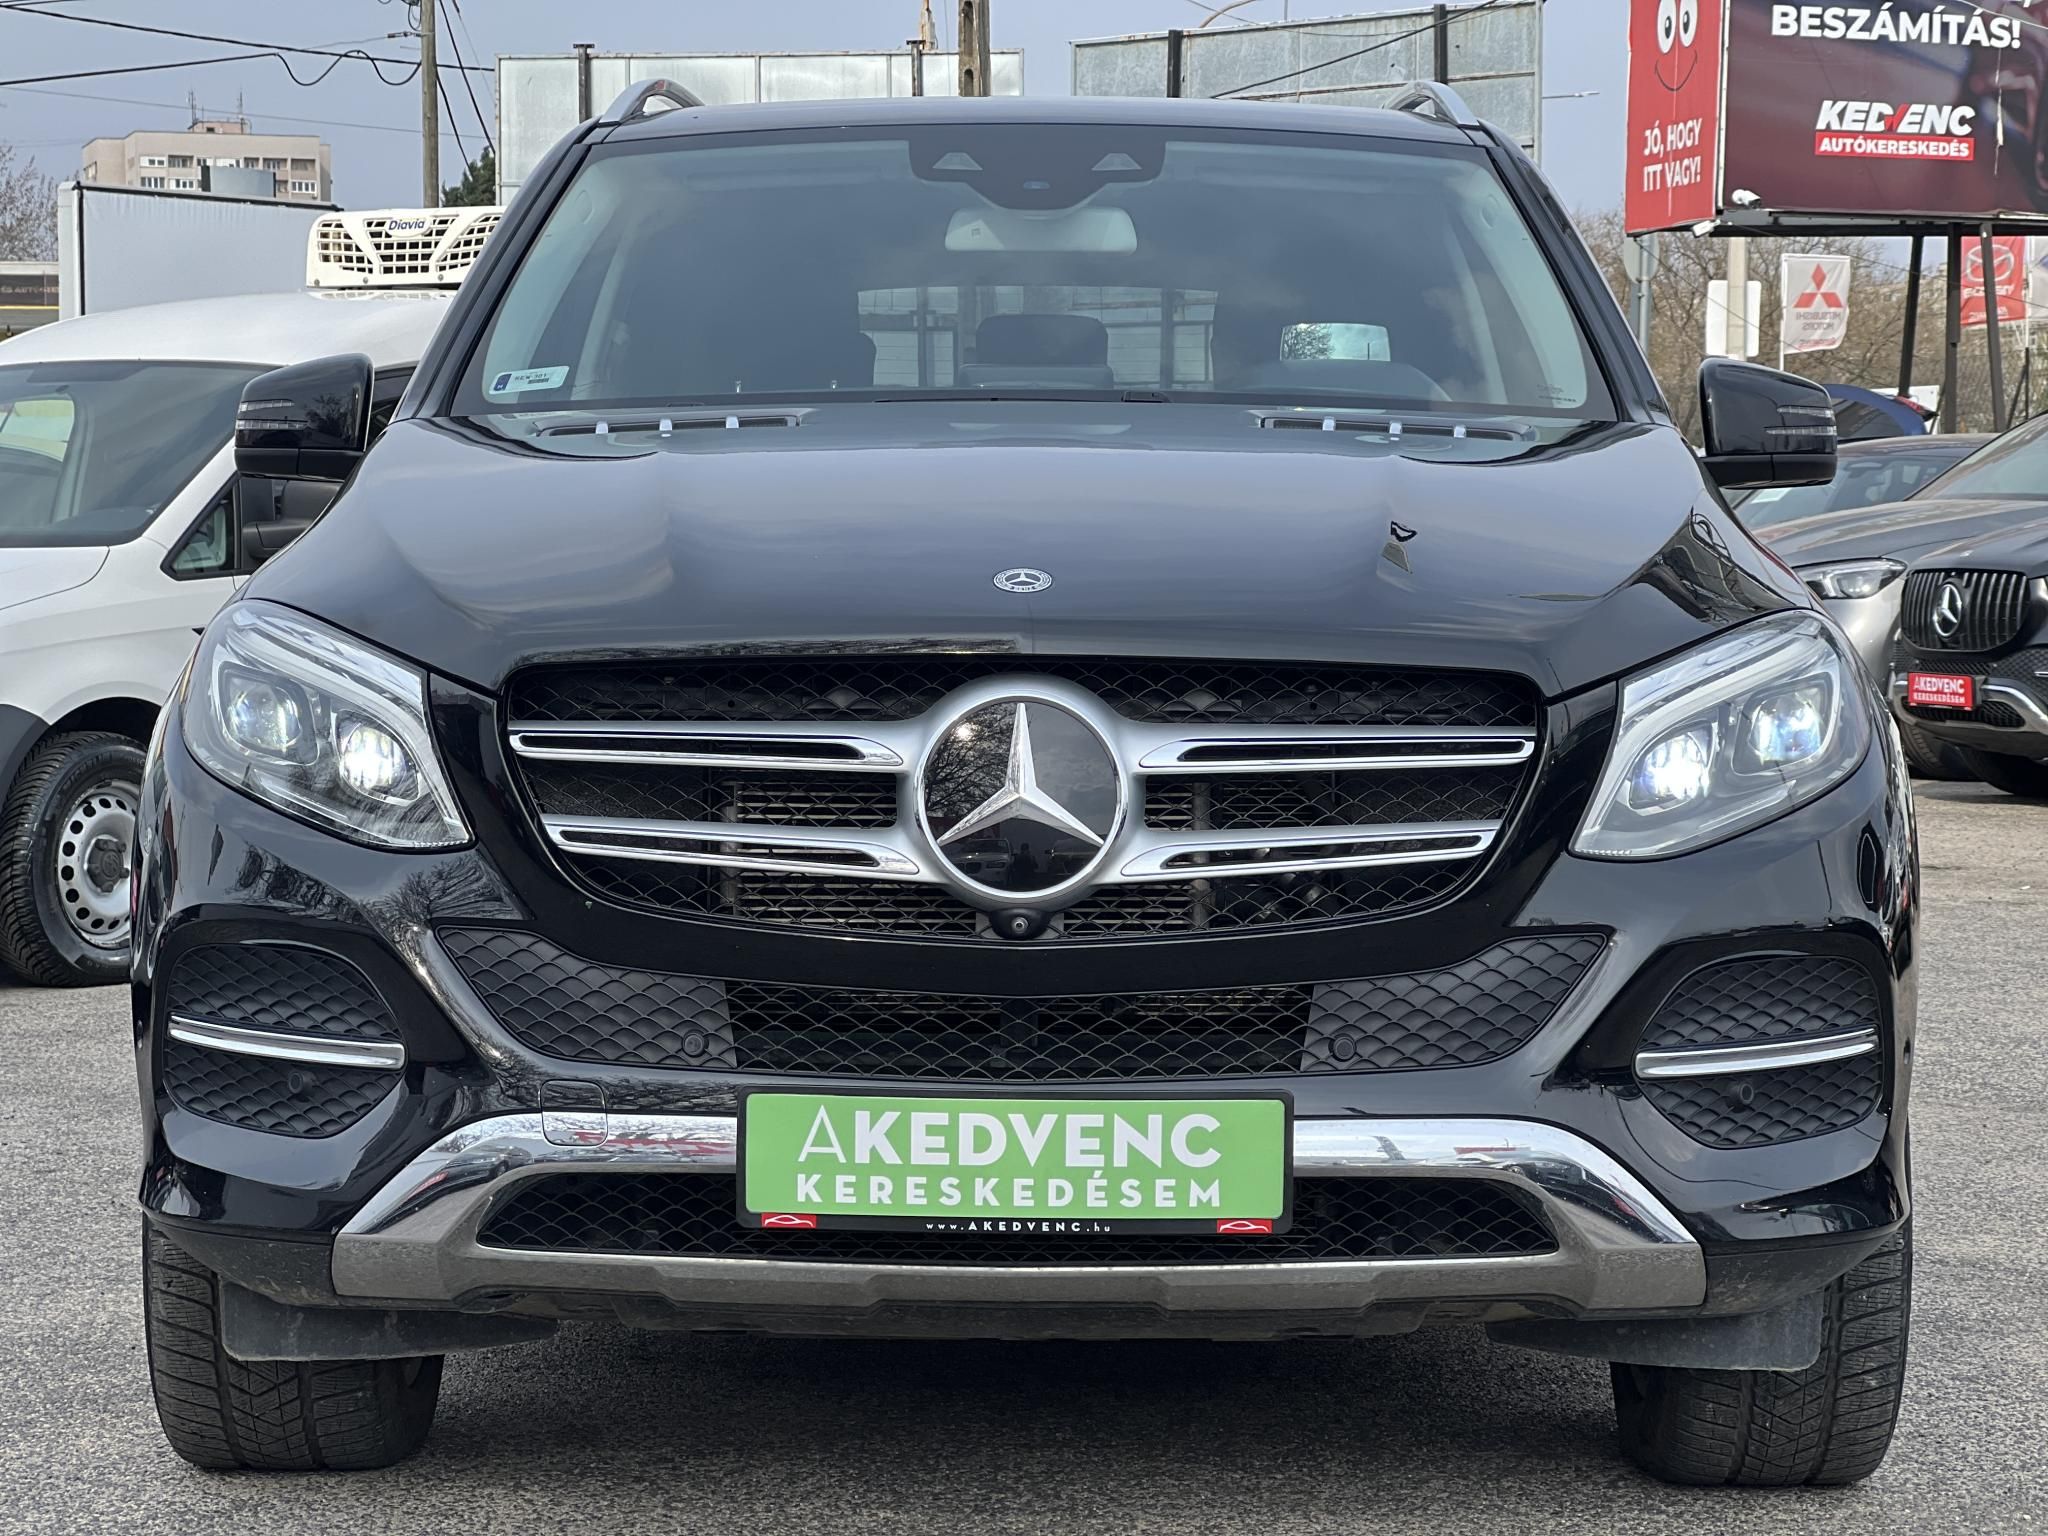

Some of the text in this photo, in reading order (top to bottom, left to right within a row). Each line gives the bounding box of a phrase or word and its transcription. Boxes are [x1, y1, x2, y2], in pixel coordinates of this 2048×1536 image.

[1771, 2, 2021, 49] BESZÁMÍTÁS!
[1643, 117, 1703, 159] JÓ, HOGY
[1819, 136, 1970, 157] AUTÓKERESKEDÉS
[1643, 155, 1702, 192] ITT VAGY!
[388, 218, 426, 231] Diavia
[1913, 675, 1966, 695] AKEDVENC
[797, 1104, 1222, 1169] AKEDVENC
[796, 1170, 1221, 1208] KERESKEDÉSEM
[926, 1221, 1111, 1233] www.AKEDVENC.hu
